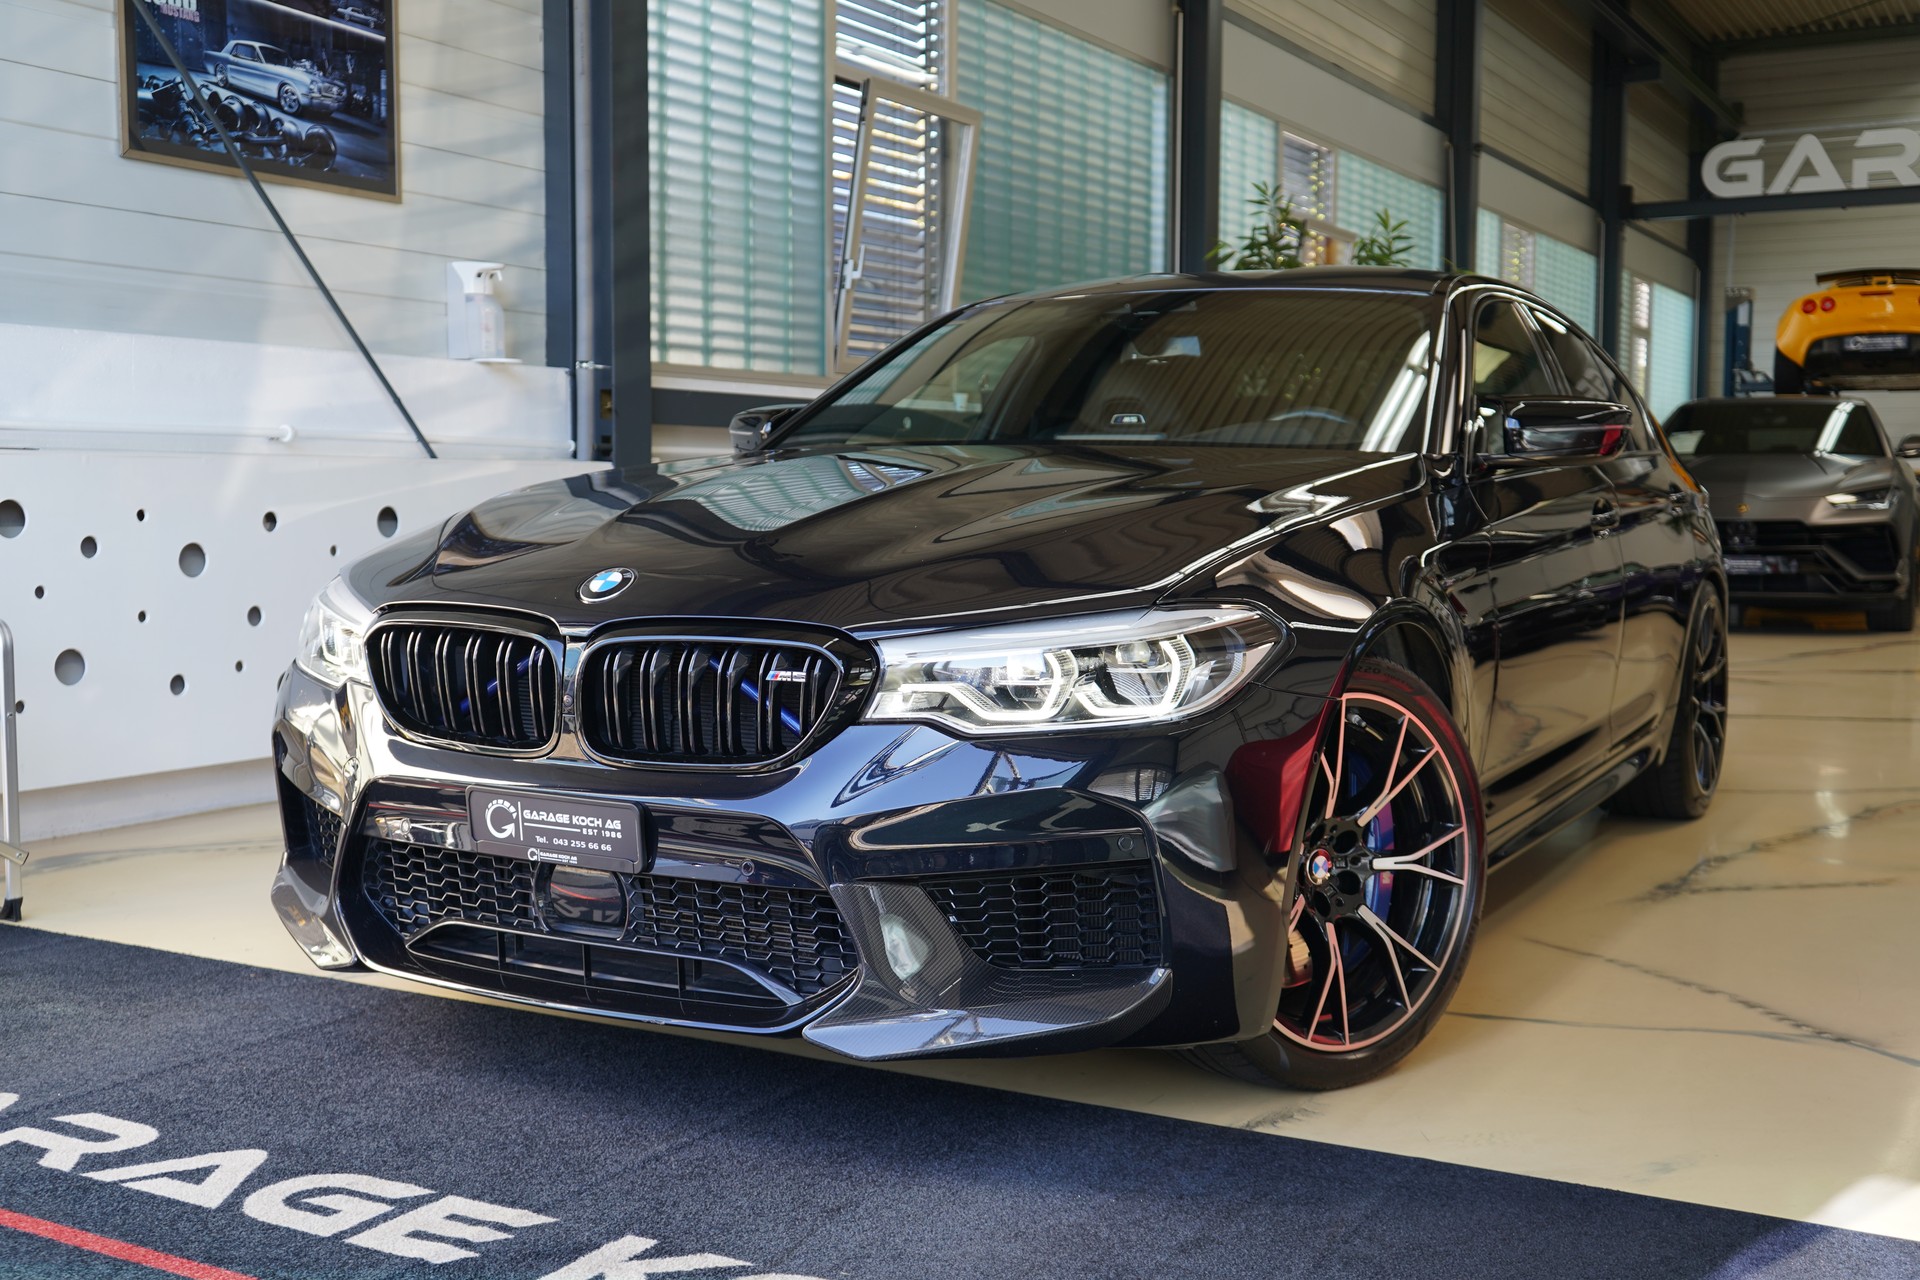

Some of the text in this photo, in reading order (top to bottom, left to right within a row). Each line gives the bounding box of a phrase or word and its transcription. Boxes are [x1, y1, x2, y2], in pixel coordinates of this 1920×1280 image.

[160, 3, 200, 23] MUSTANG
[523, 809, 621, 830] GARAGE KOCH AG
[535, 835, 612, 852] Tel. 043 255 66 66
[582, 828, 622, 839] EST 1986
[0, 1092, 559, 1264] RAGE
